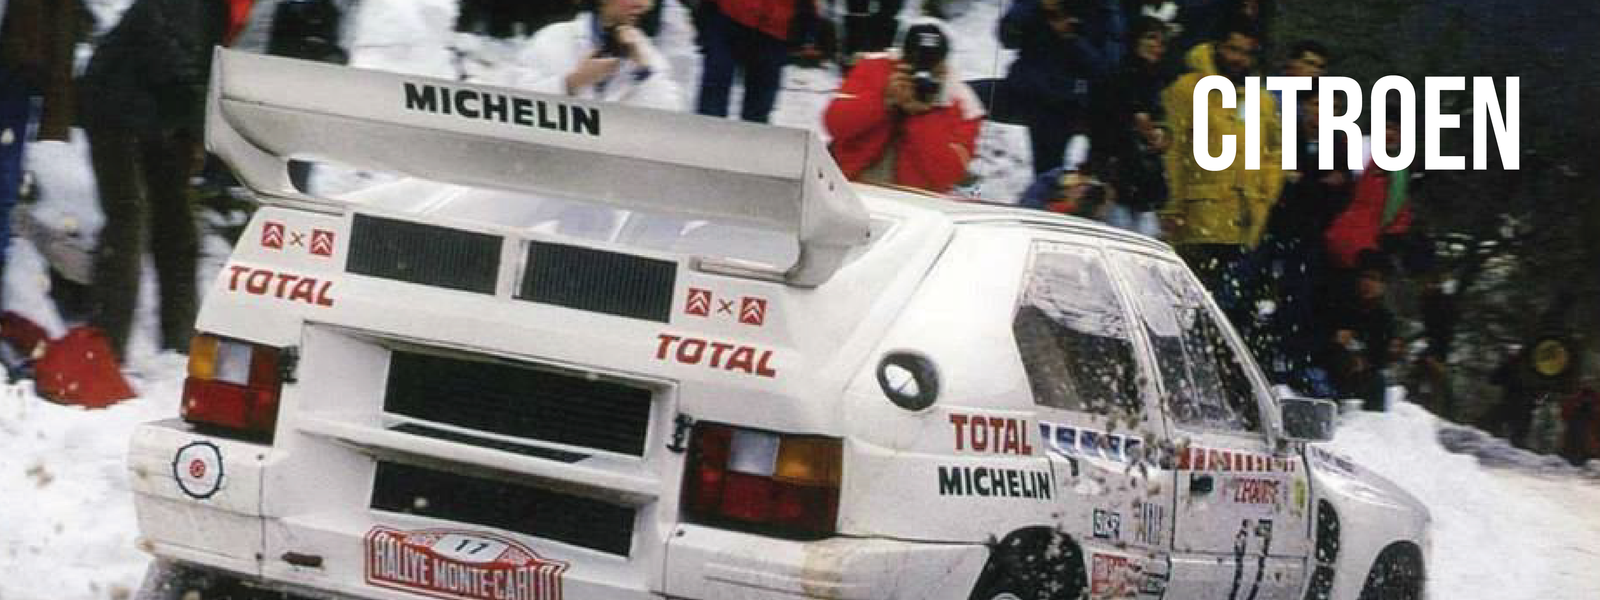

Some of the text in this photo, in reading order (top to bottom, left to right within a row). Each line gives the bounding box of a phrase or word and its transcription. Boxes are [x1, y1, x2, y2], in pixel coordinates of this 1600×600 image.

[404, 82, 601, 136] MICHELIN
[228, 265, 334, 307] TOTAL
[656, 334, 777, 378] TOTAL
[949, 414, 1033, 456] TOTAL
[938, 466, 1051, 500] MICHELIN
[373, 532, 429, 584] RALLYE
[455, 539, 490, 555] 17
